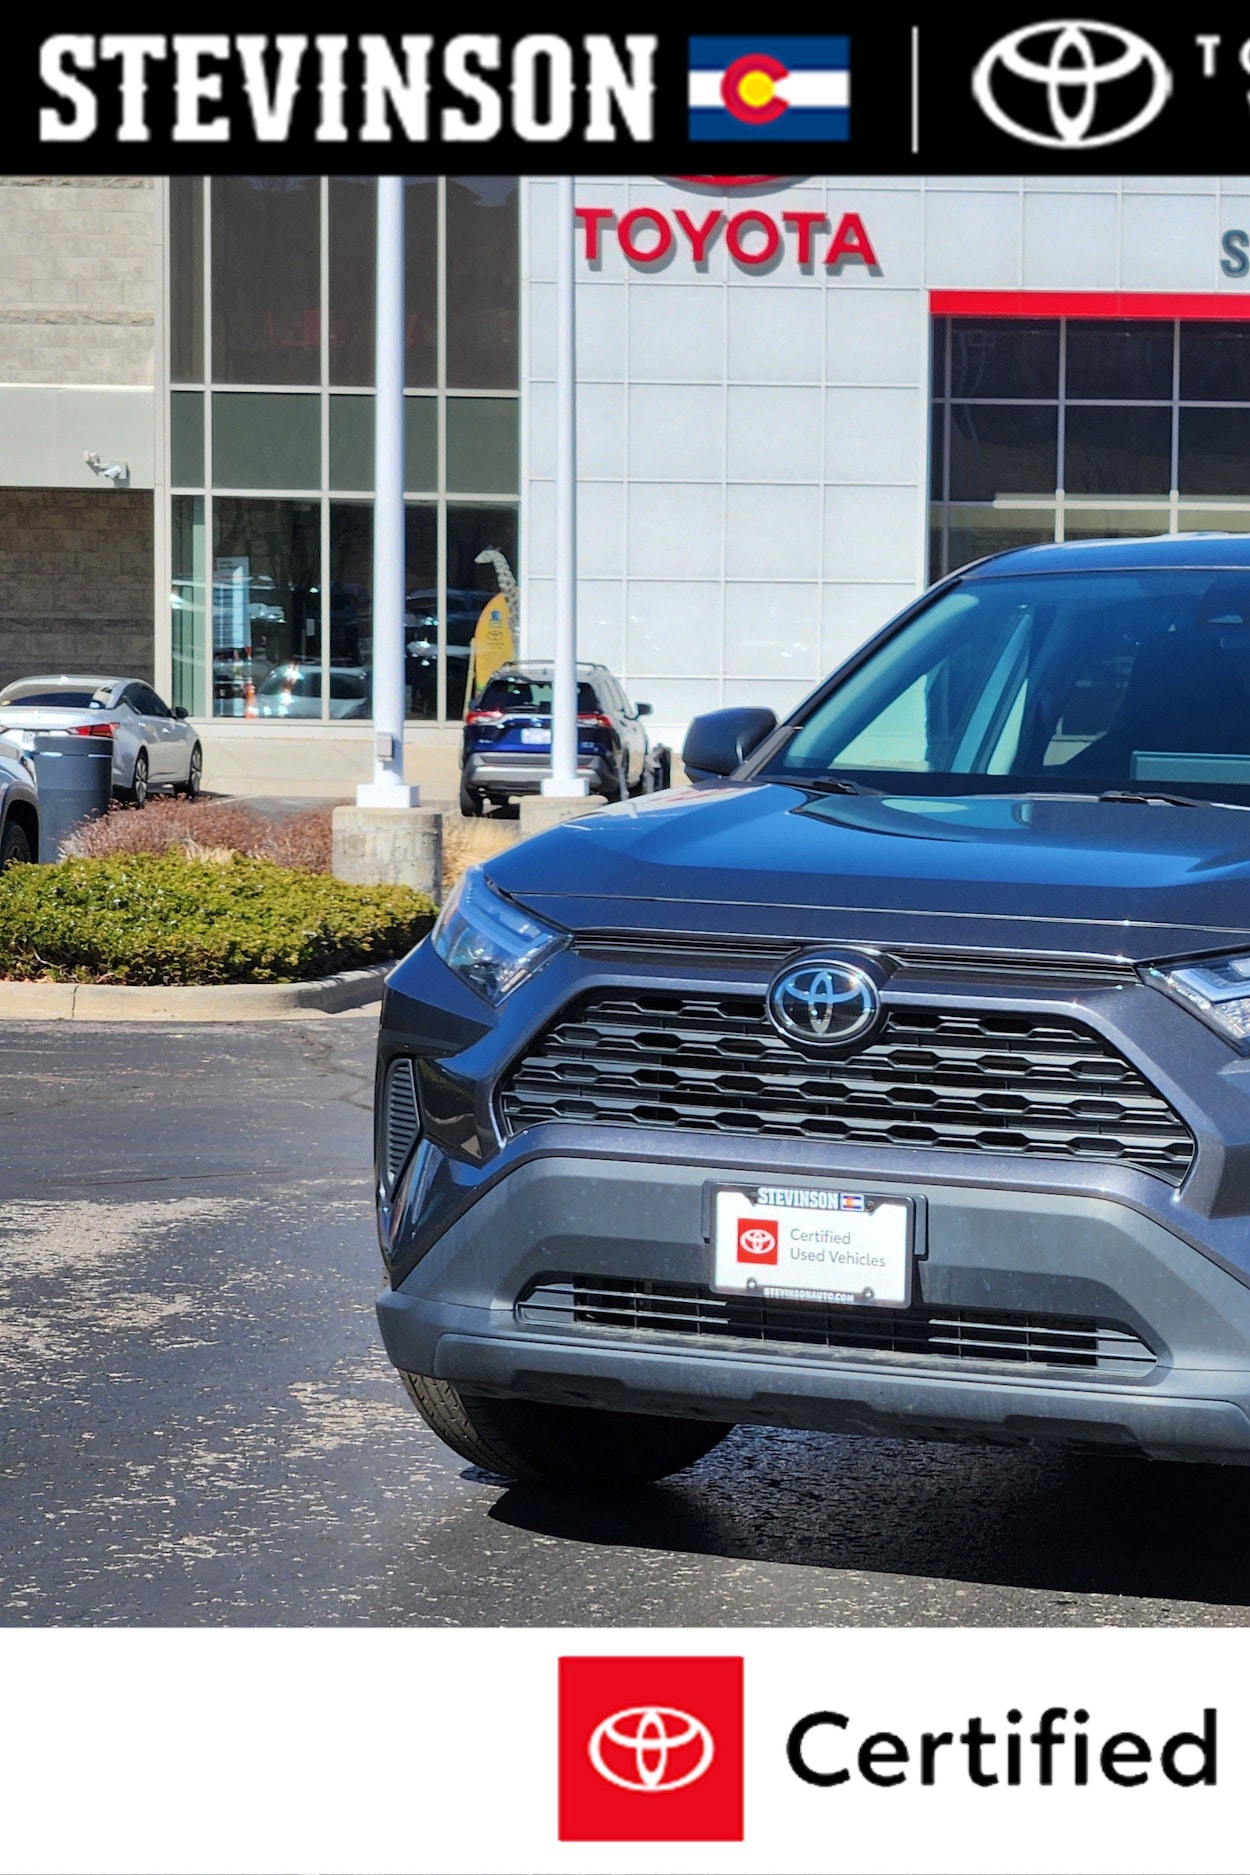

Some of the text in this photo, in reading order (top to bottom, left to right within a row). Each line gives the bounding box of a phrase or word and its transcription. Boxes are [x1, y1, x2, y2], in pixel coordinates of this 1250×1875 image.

[574, 207, 878, 267] TOYOTA
[757, 1187, 838, 1210] STEVINSON
[790, 1228, 851, 1245] Certified
[790, 1247, 887, 1268] Used Vehicles
[763, 1287, 855, 1303] STEVINSONAUTO.COM
